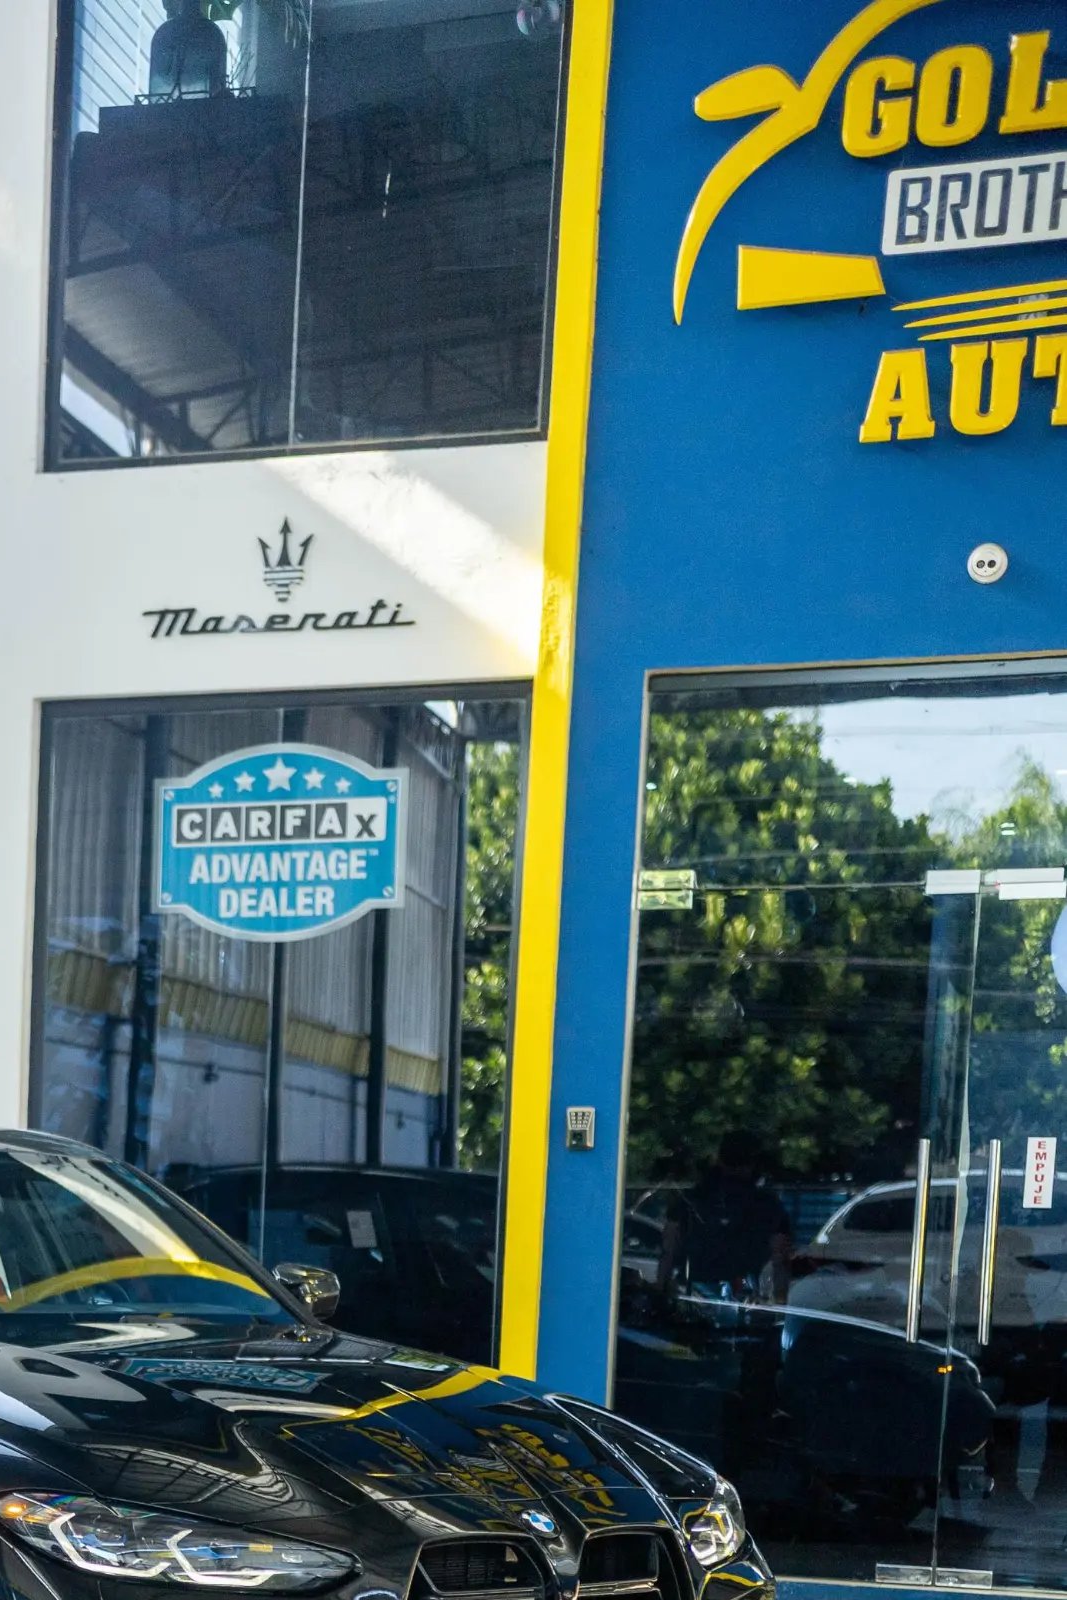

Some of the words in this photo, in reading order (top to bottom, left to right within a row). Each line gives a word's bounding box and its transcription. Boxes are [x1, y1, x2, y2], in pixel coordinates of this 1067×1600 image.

[841, 30, 1067, 158] GOL
[142, 599, 416, 638] Maserati
[177, 803, 378, 843] CARFAX
[219, 885, 335, 919] DEALER
[1033, 1140, 1048, 1205] EMPUJE
